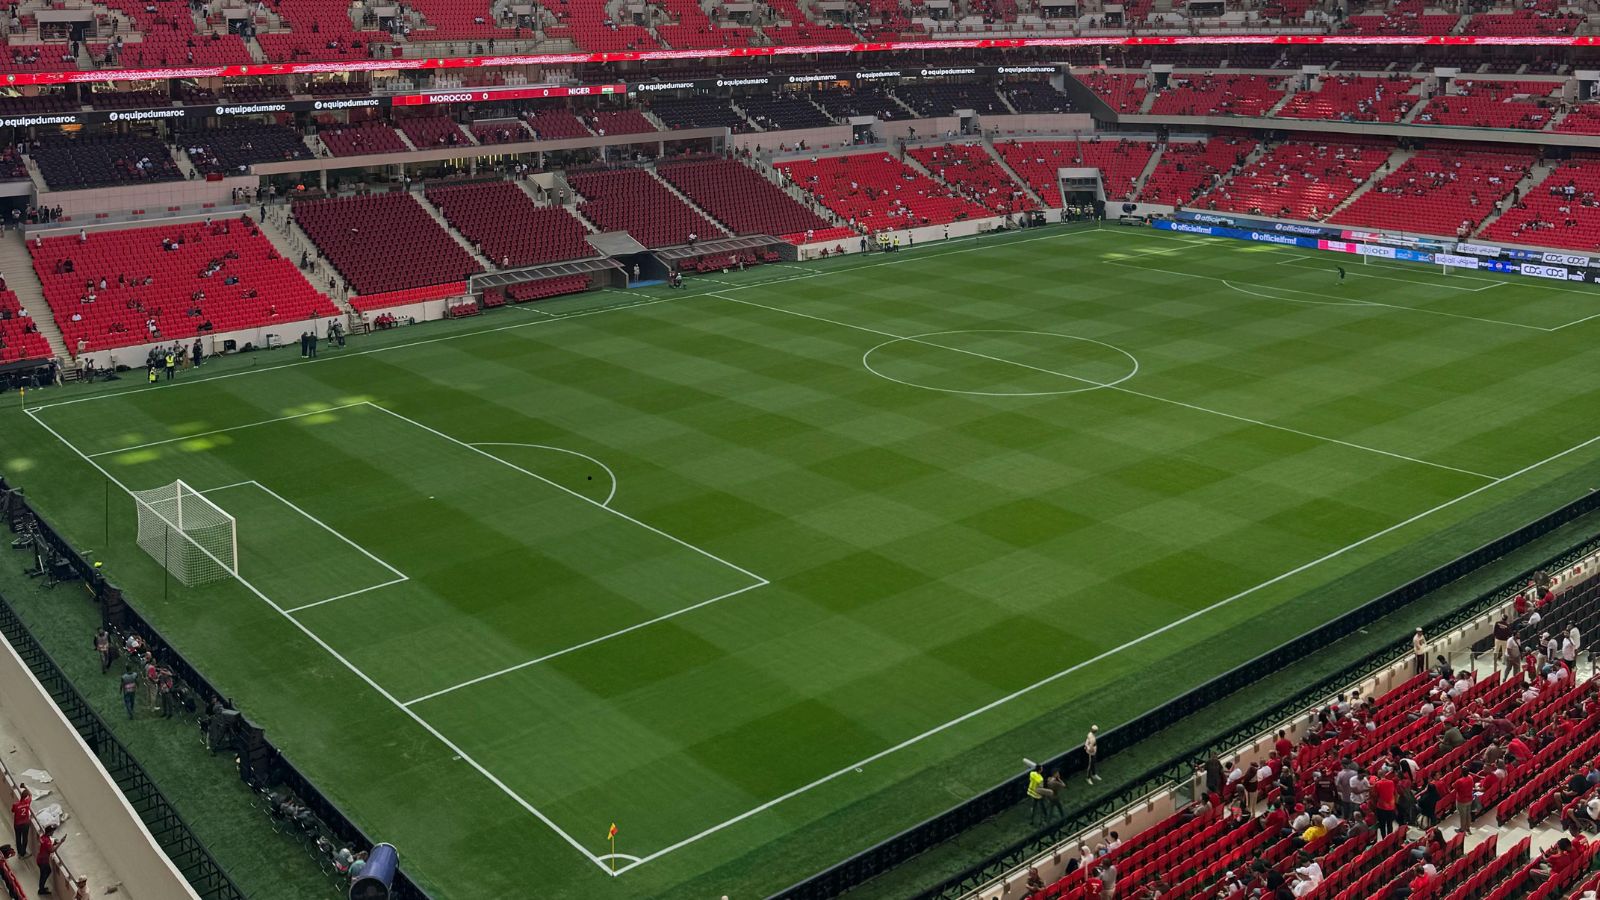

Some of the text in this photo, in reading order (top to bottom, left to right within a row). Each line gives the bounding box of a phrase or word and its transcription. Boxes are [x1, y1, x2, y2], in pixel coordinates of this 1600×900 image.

[645, 82, 694, 90] equipedumaroc
[723, 78, 769, 86] equipedumaroc
[429, 93, 472, 103] MOROCCO
[568, 87, 591, 95] NIGER
[224, 104, 286, 115] equipedumaroc
[322, 99, 379, 109] equipedumaroc
[4, 115, 76, 127] equipedumaroc
[119, 110, 185, 121] equipedumaroc
[1545, 254, 1563, 263] CDG
[1567, 256, 1585, 265] CDG
[1524, 265, 1542, 275] CDG
[1545, 268, 1565, 278] CDG
[21, 808, 26, 816] 2
